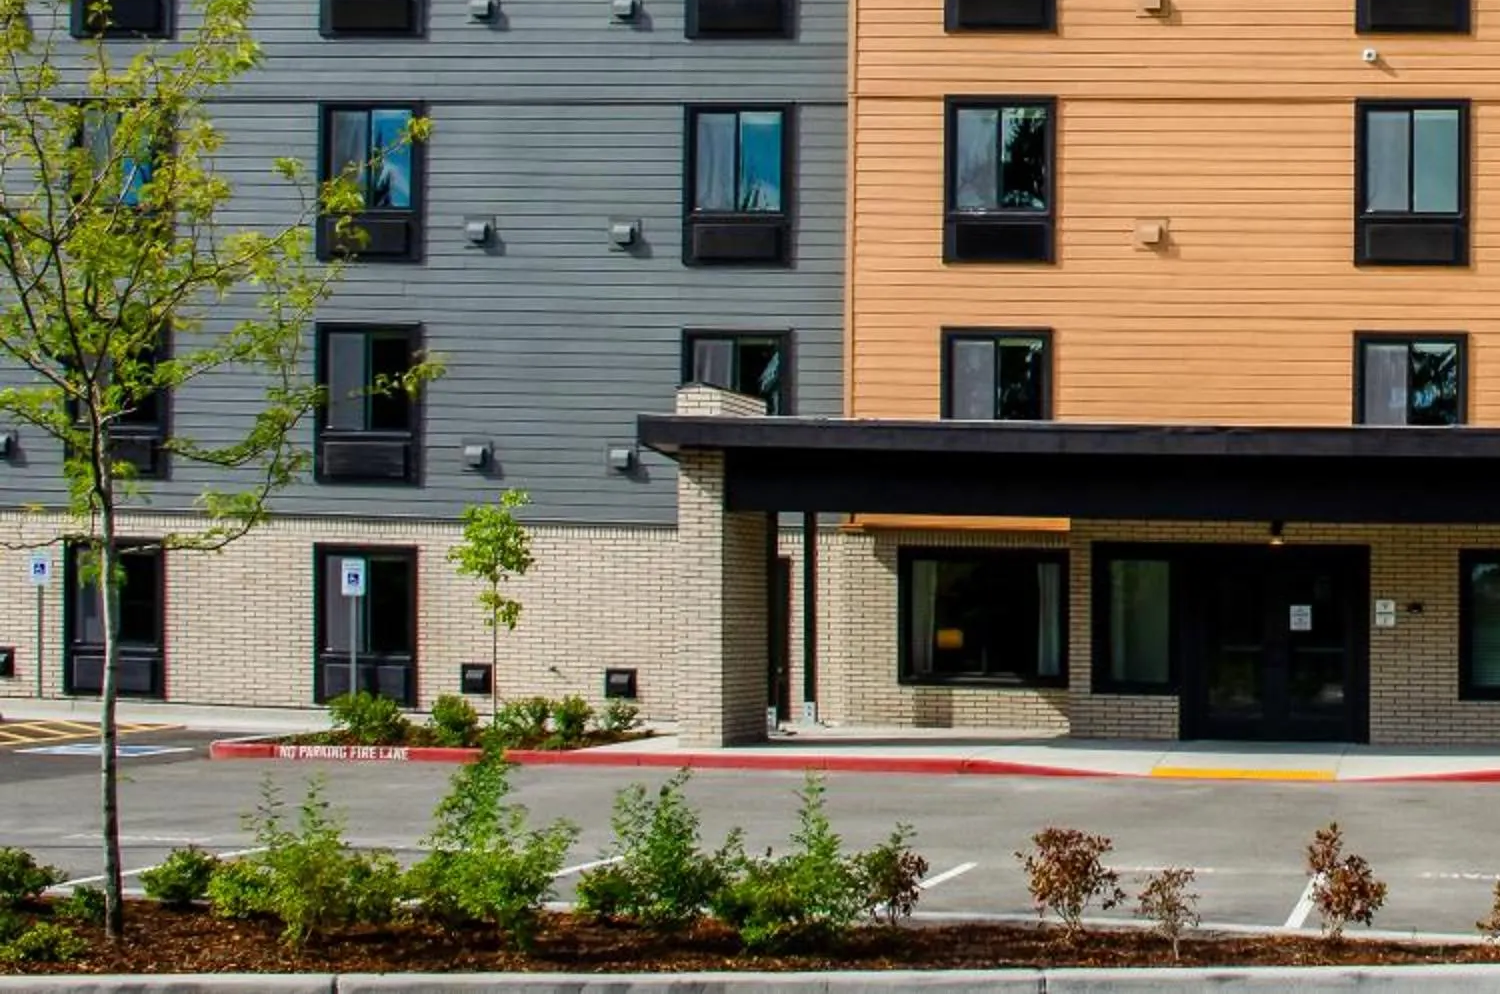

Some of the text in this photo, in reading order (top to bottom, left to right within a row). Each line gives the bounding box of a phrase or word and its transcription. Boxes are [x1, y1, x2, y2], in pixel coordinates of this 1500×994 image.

[280, 746, 409, 761] NO PARKING FIRE LANE
